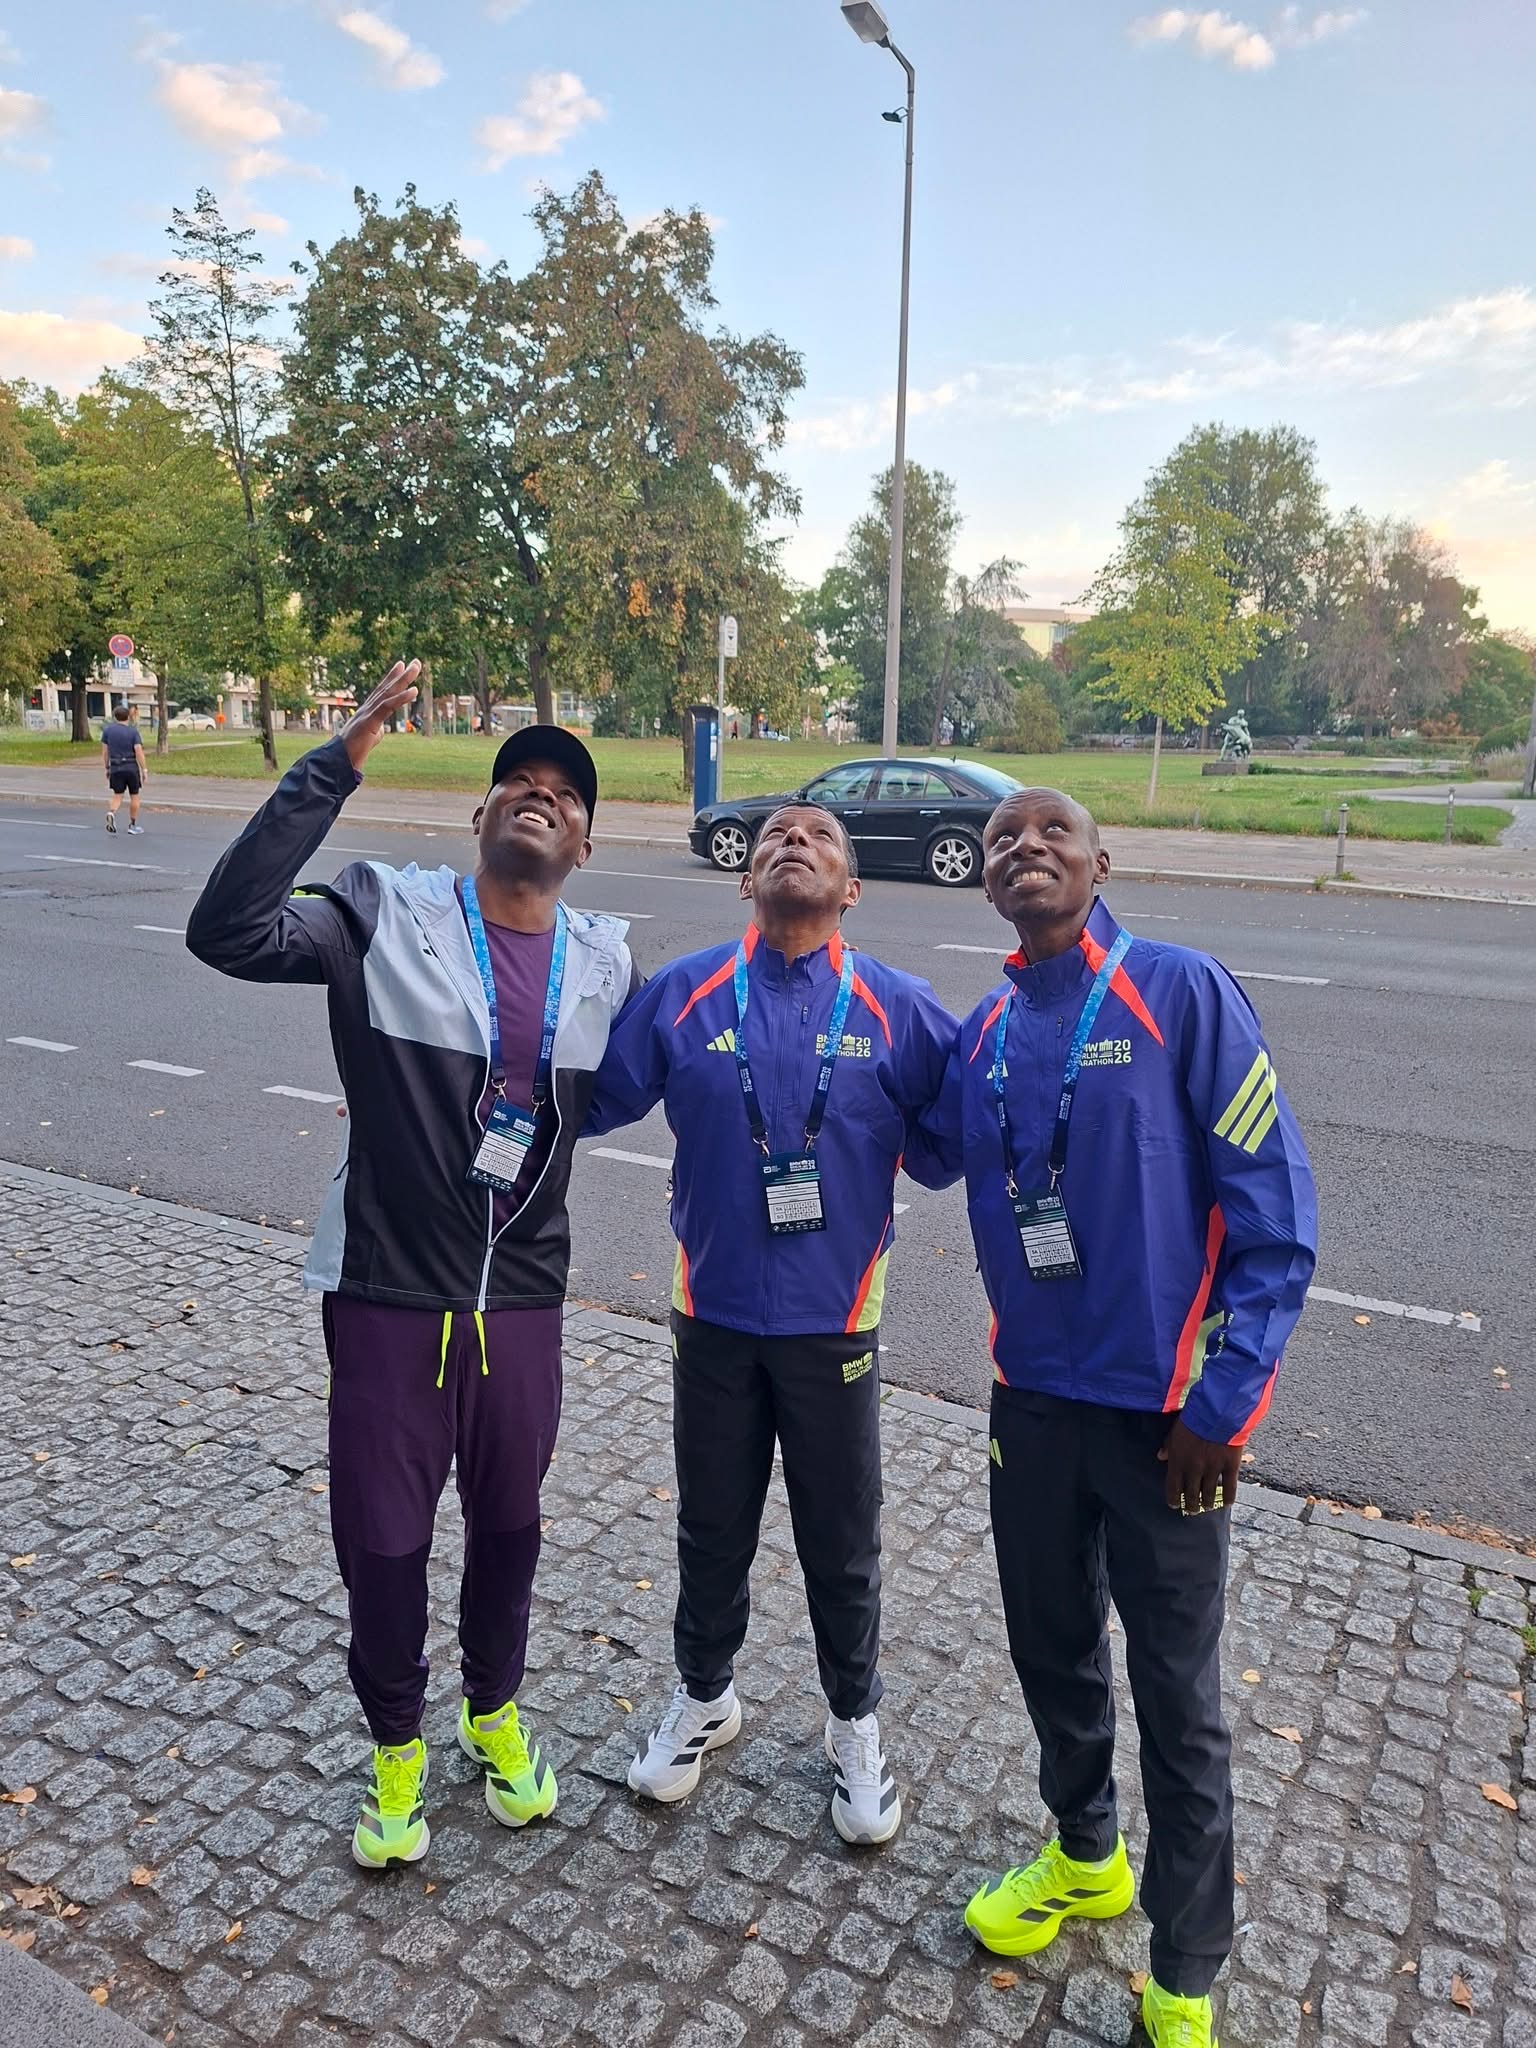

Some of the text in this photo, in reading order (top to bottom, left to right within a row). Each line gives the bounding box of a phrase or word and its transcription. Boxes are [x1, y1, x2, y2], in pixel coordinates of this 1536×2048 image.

[855, 1037, 871, 1047] 20
[1113, 1039, 1131, 1051] 20
[856, 1047, 871, 1057] 26
[1114, 1051, 1132, 1064] 26
[1079, 1058, 1114, 1067] ARATHON
[842, 1357, 863, 1372] BMW
